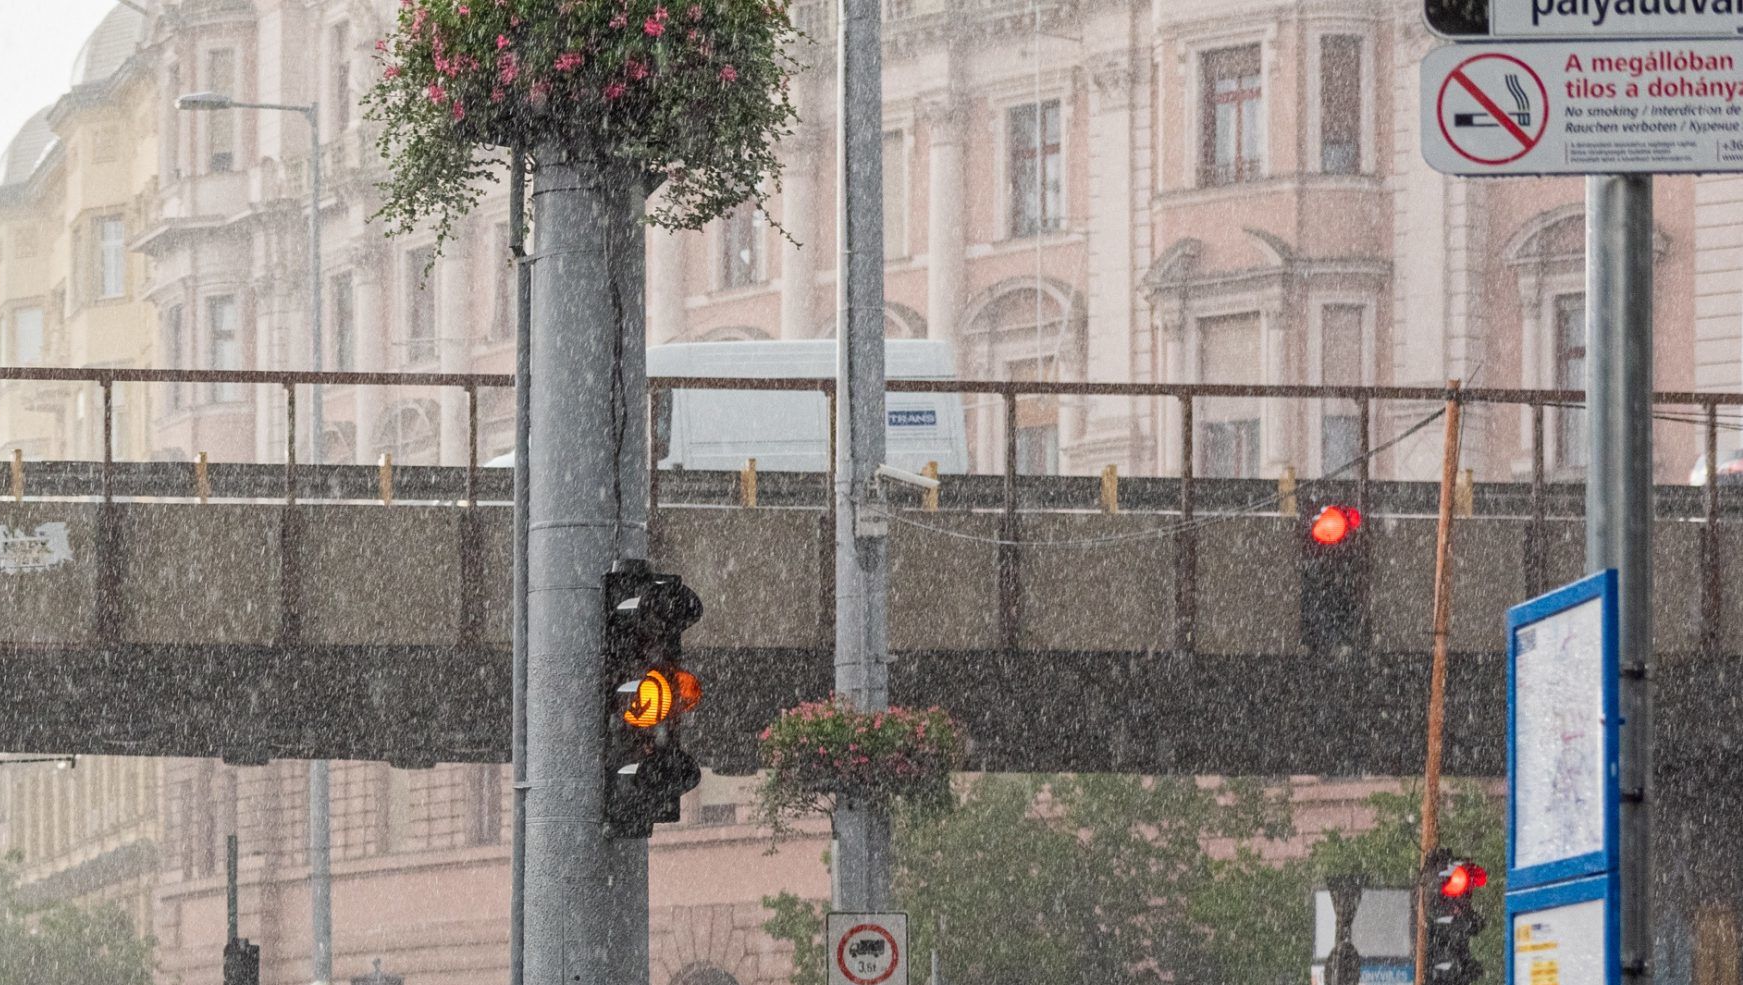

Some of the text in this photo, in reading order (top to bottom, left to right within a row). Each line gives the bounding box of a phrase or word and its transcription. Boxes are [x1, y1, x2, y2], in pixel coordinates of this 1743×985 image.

[1564, 50, 1733, 77] A megállóban
[1565, 78, 1616, 98] tilos
[1625, 82, 1639, 98] a
[1564, 106, 1583, 117] No
[1588, 105, 1639, 119] smoking
[1726, 104, 1742, 115] de
[1565, 121, 1618, 133] Rauchen
[1623, 120, 1677, 133] verboten
